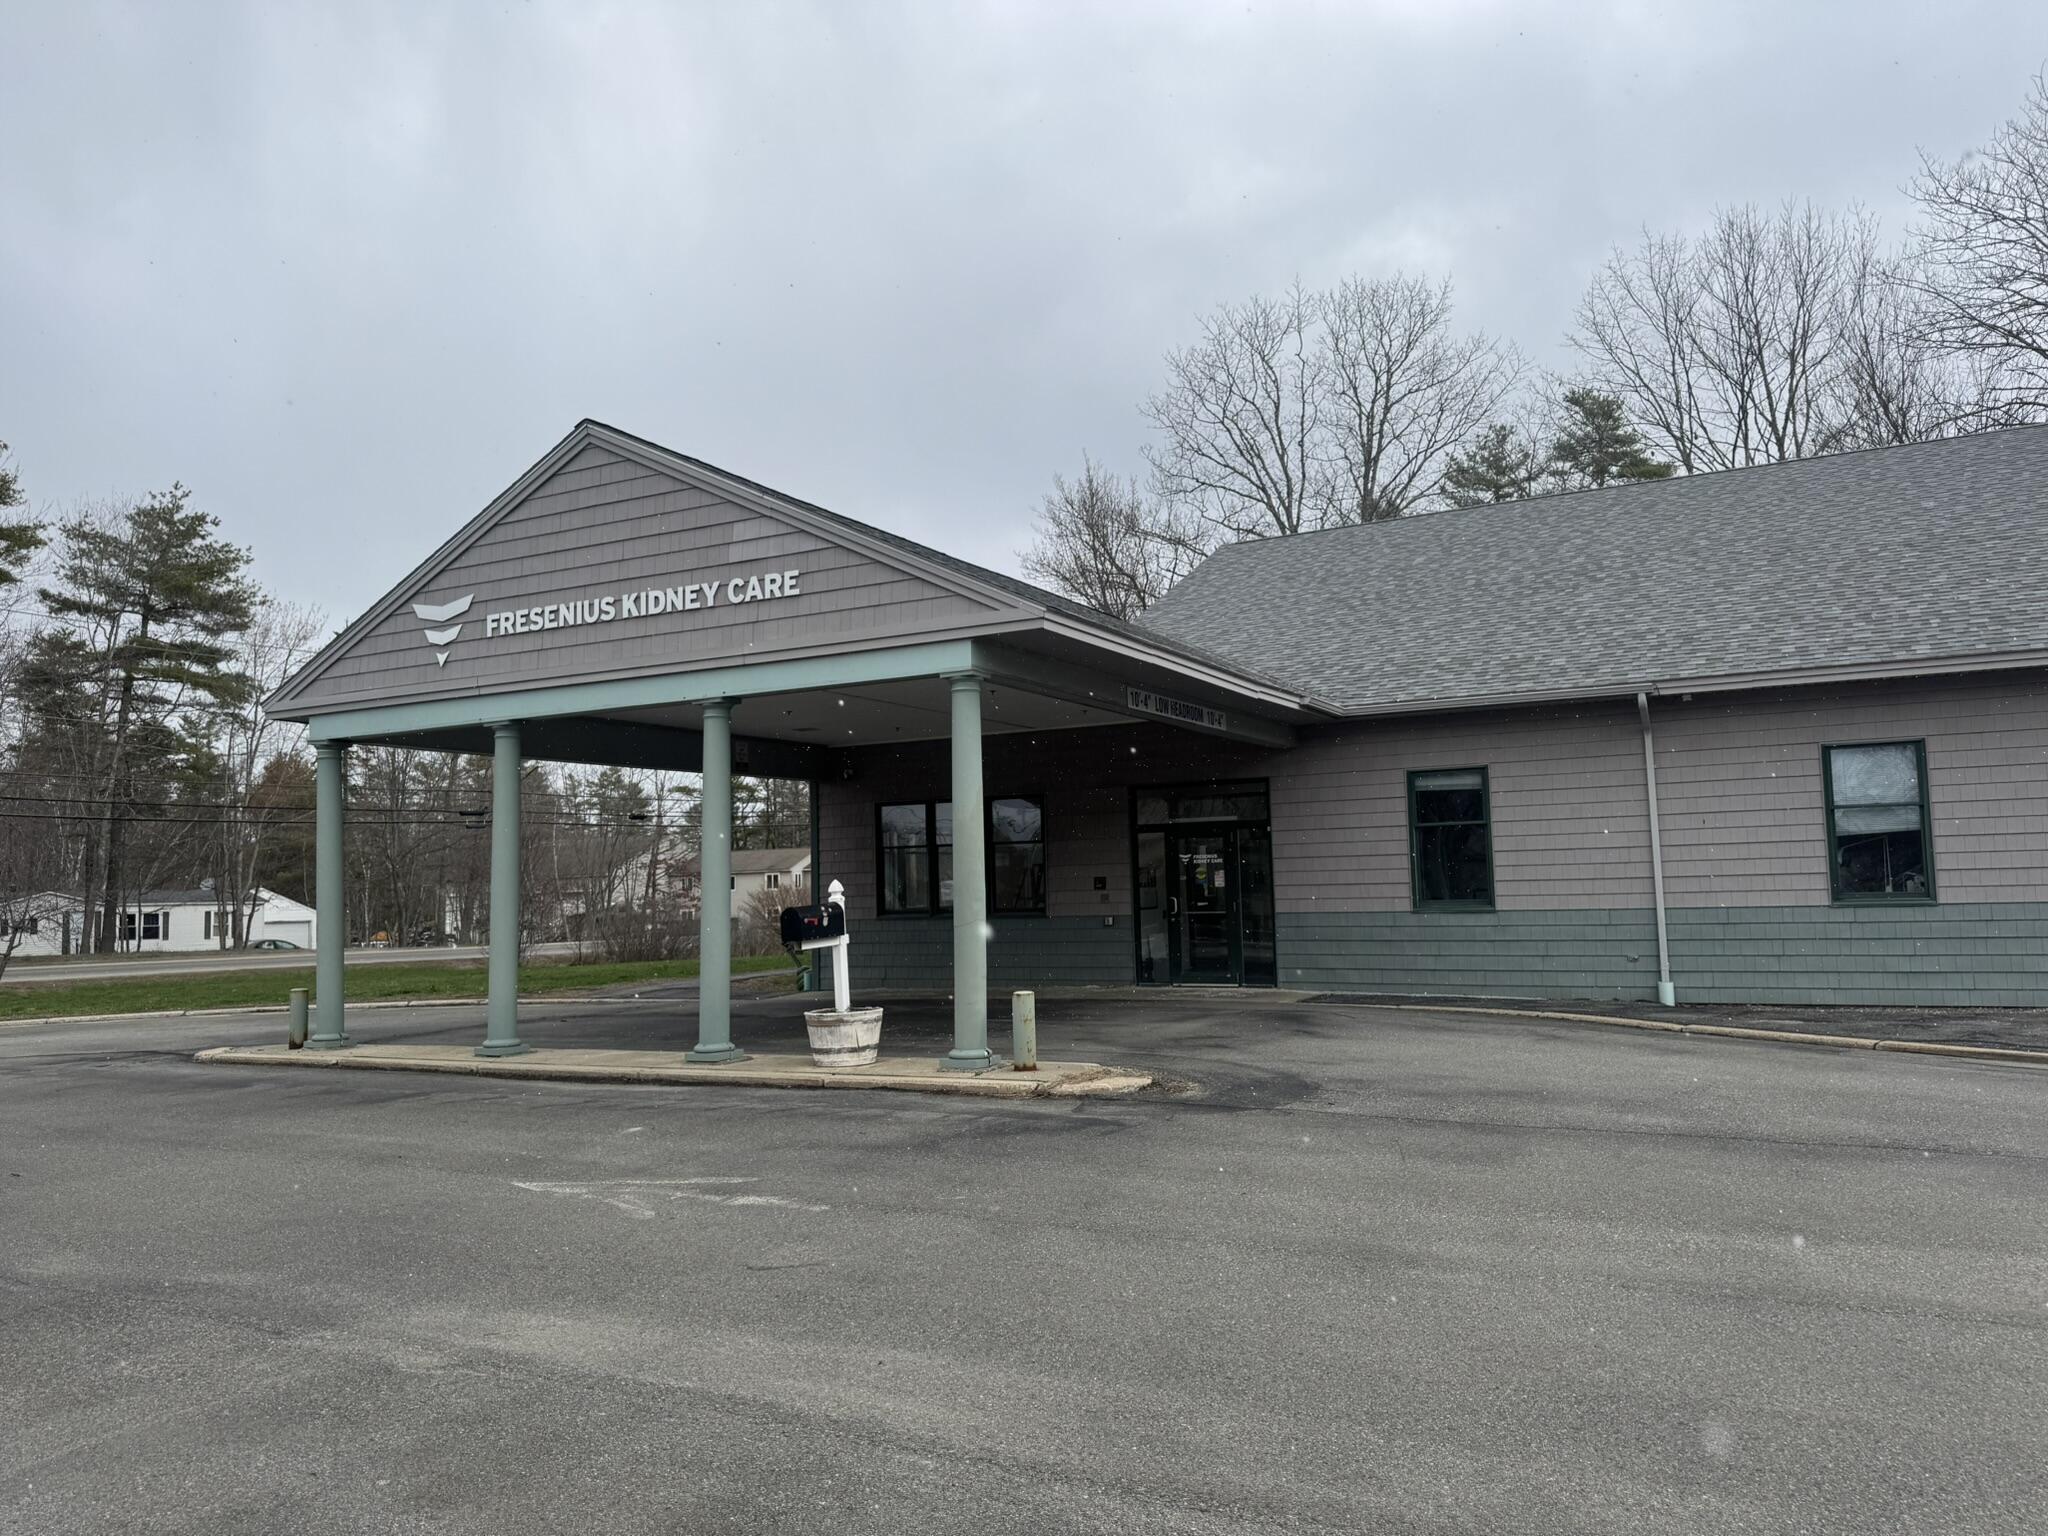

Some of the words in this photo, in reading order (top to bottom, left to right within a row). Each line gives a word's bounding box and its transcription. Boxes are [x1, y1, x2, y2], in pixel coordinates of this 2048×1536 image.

[486, 597, 615, 638] FRESENIUS
[622, 581, 721, 619] KIDNEY
[727, 570, 800, 605] CARE
[1154, 695, 1169, 714] LOW
